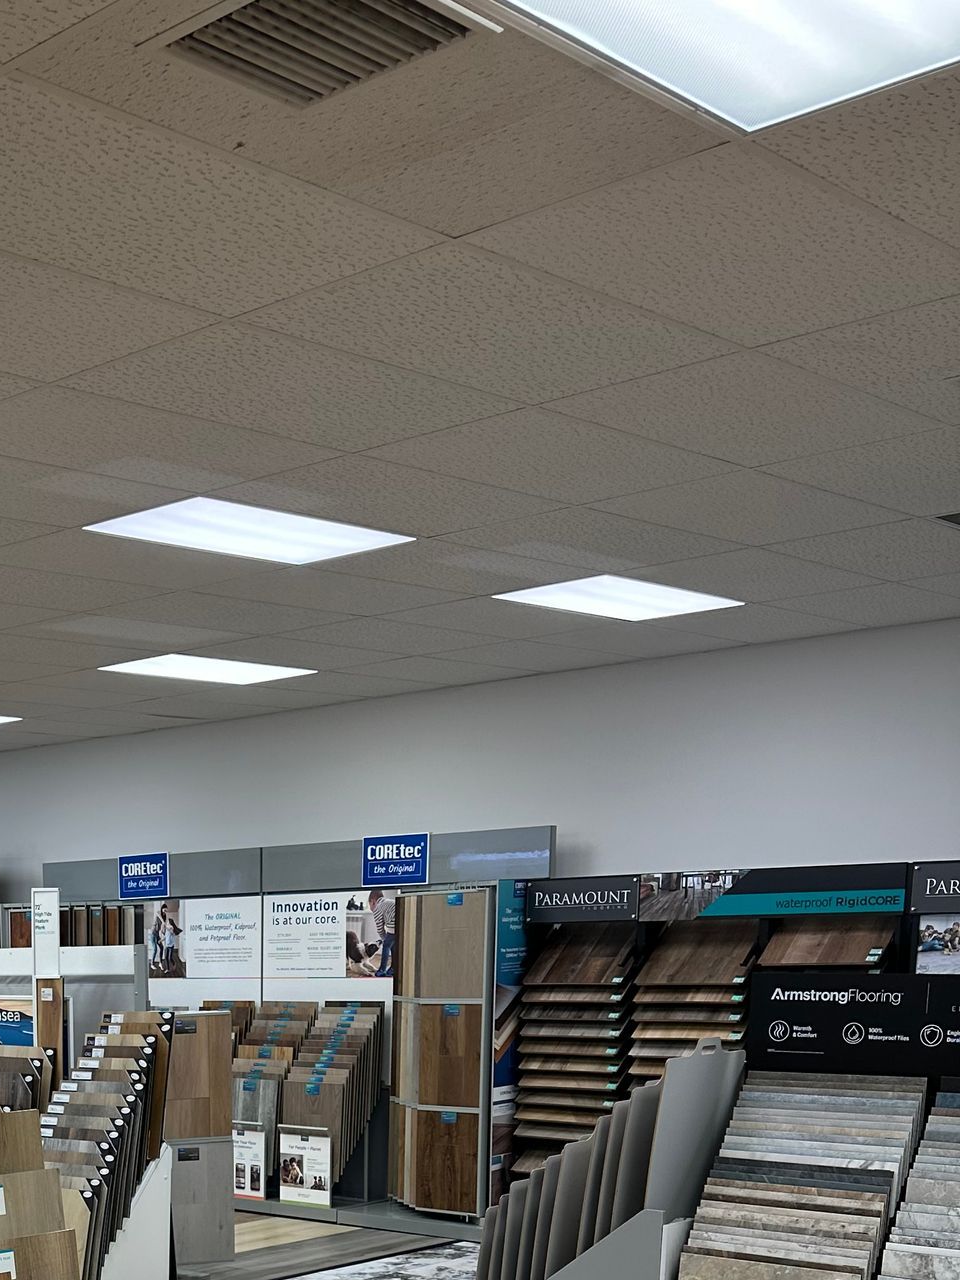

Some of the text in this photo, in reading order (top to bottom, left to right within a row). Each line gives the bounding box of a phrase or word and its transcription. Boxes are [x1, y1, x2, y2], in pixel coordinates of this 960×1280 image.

[367, 844, 422, 860] COREtec
[122, 861, 163, 877] COREtec
[373, 862, 416, 875] the Original
[127, 878, 160, 890] the Original
[535, 889, 631, 906] PARAMOUNT
[775, 895, 900, 909] waterproof RigidCORE
[272, 899, 338, 913] Innovation
[272, 915, 340, 926] is at our core.
